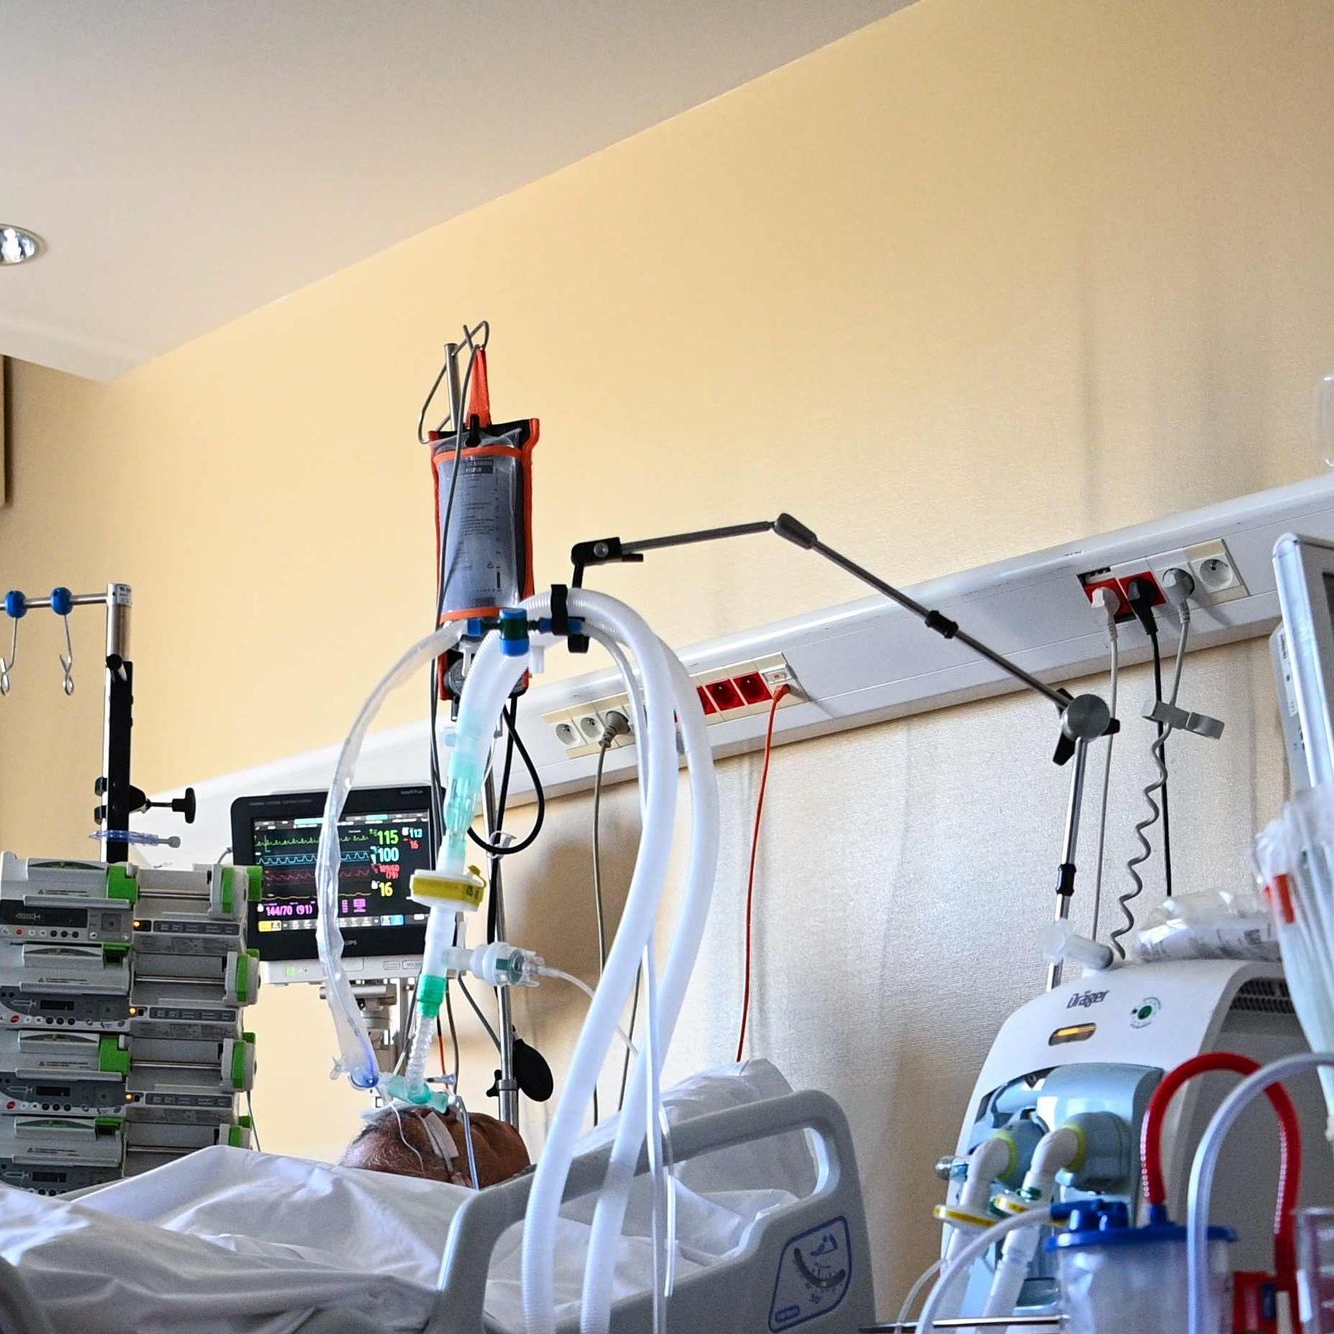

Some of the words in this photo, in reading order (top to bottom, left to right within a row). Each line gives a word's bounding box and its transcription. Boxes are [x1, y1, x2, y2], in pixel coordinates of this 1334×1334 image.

[377, 829, 399, 845] 115
[377, 846, 400, 863] 100
[378, 881, 394, 897] 16
[265, 904, 293, 917] 144/70
[296, 903, 313, 916] (91)
[1066, 989, 1110, 1009] Dräger
